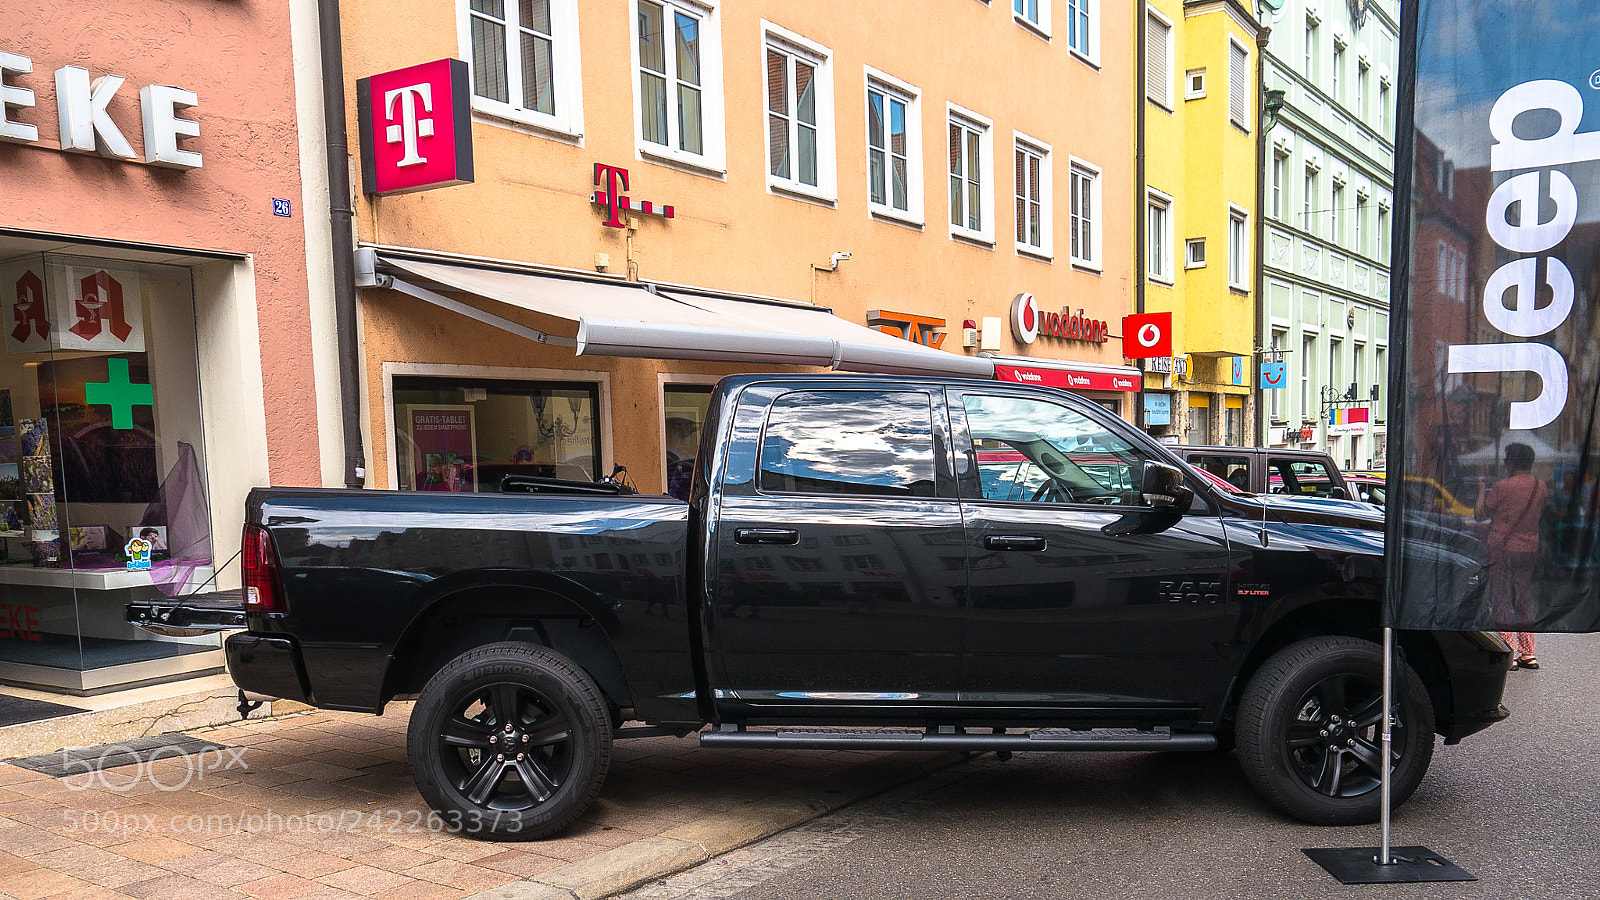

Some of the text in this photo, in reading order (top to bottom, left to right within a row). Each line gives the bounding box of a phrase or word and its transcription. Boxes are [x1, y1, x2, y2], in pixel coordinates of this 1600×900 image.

[385, 82, 434, 168] T
[273, 200, 291, 216] 26
[1447, 79, 1600, 430] Jeep
[1037, 306, 1109, 344] vodafone
[1020, 371, 1042, 382] vodafone
[1073, 375, 1091, 386] vodafone
[1117, 379, 1133, 388] vodafone
[415, 415, 467, 424] GRATIS-TABLET
